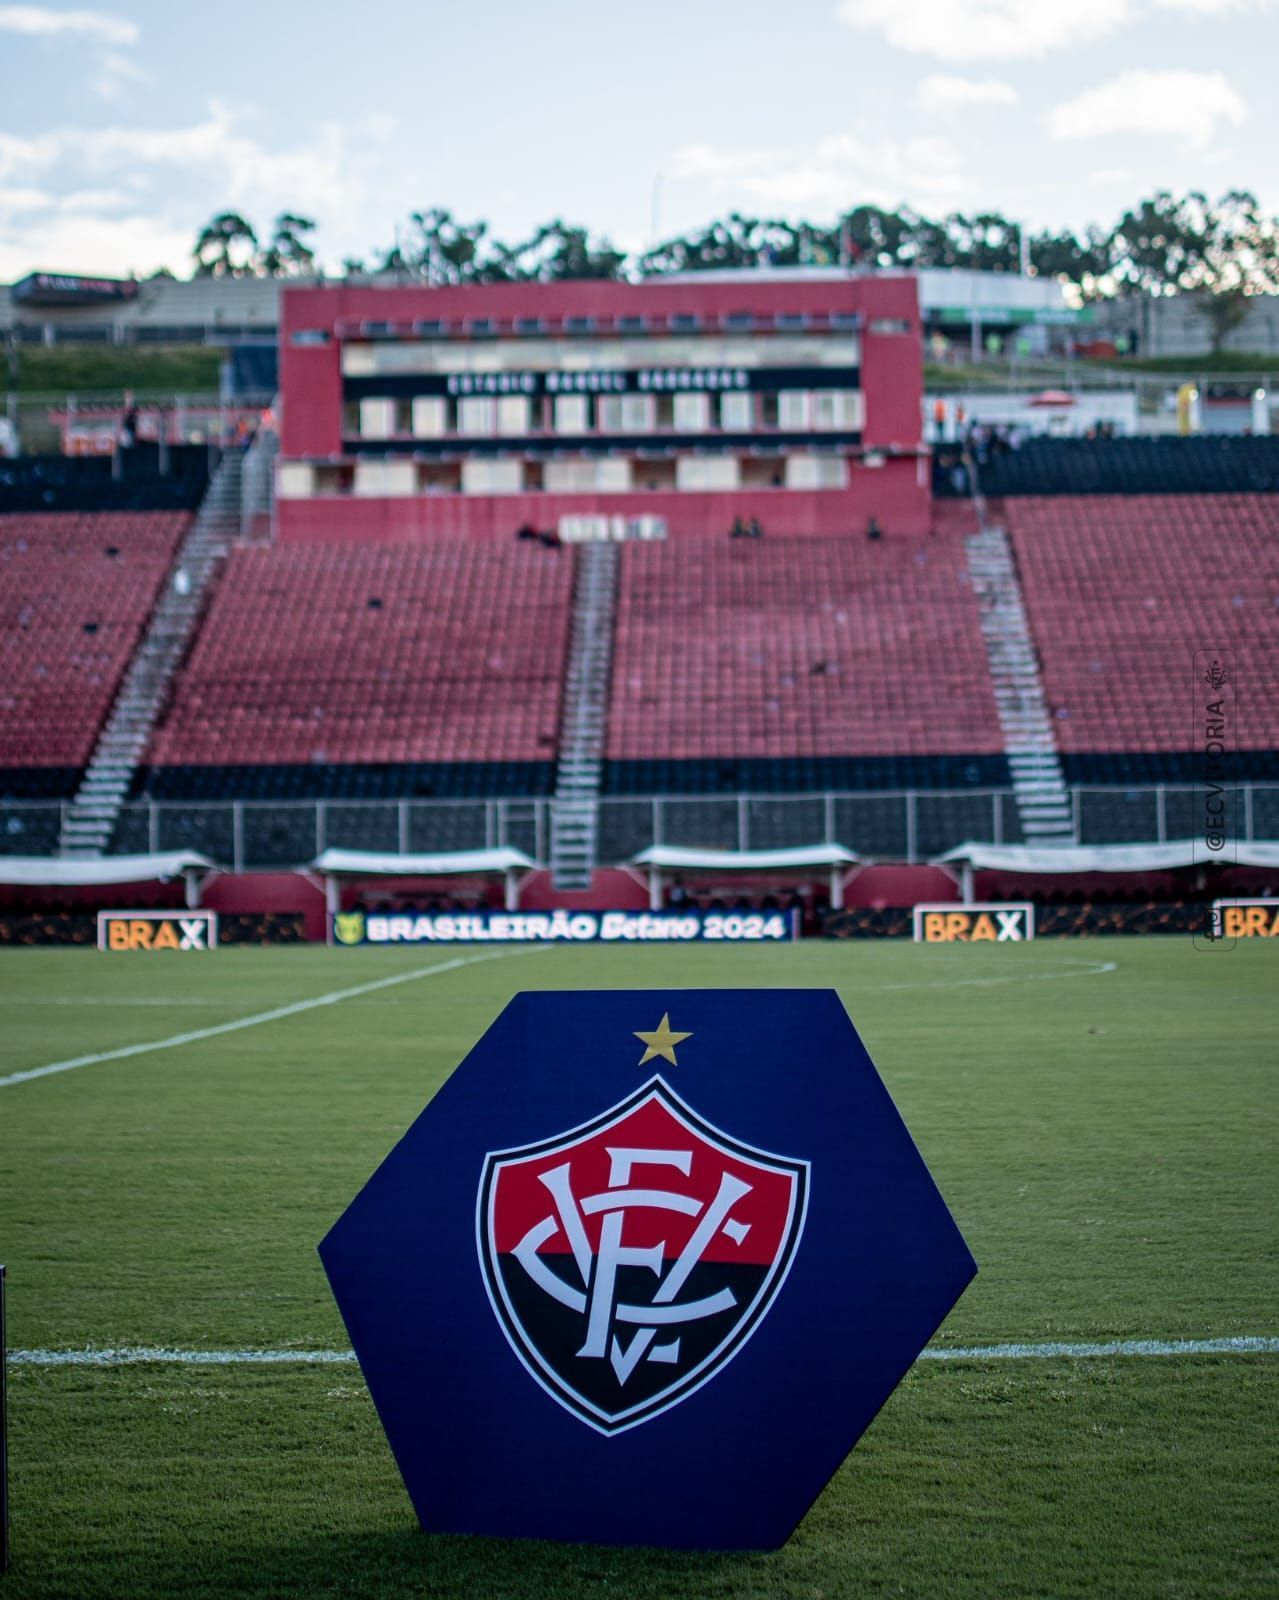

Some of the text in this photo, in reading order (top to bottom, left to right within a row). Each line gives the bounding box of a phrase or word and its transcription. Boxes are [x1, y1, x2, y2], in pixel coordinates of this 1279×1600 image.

[108, 919, 206, 950] BRAX
[366, 910, 786, 940] BRASILEIRÃO Betano 2024
[925, 911, 1022, 942] BRAX
